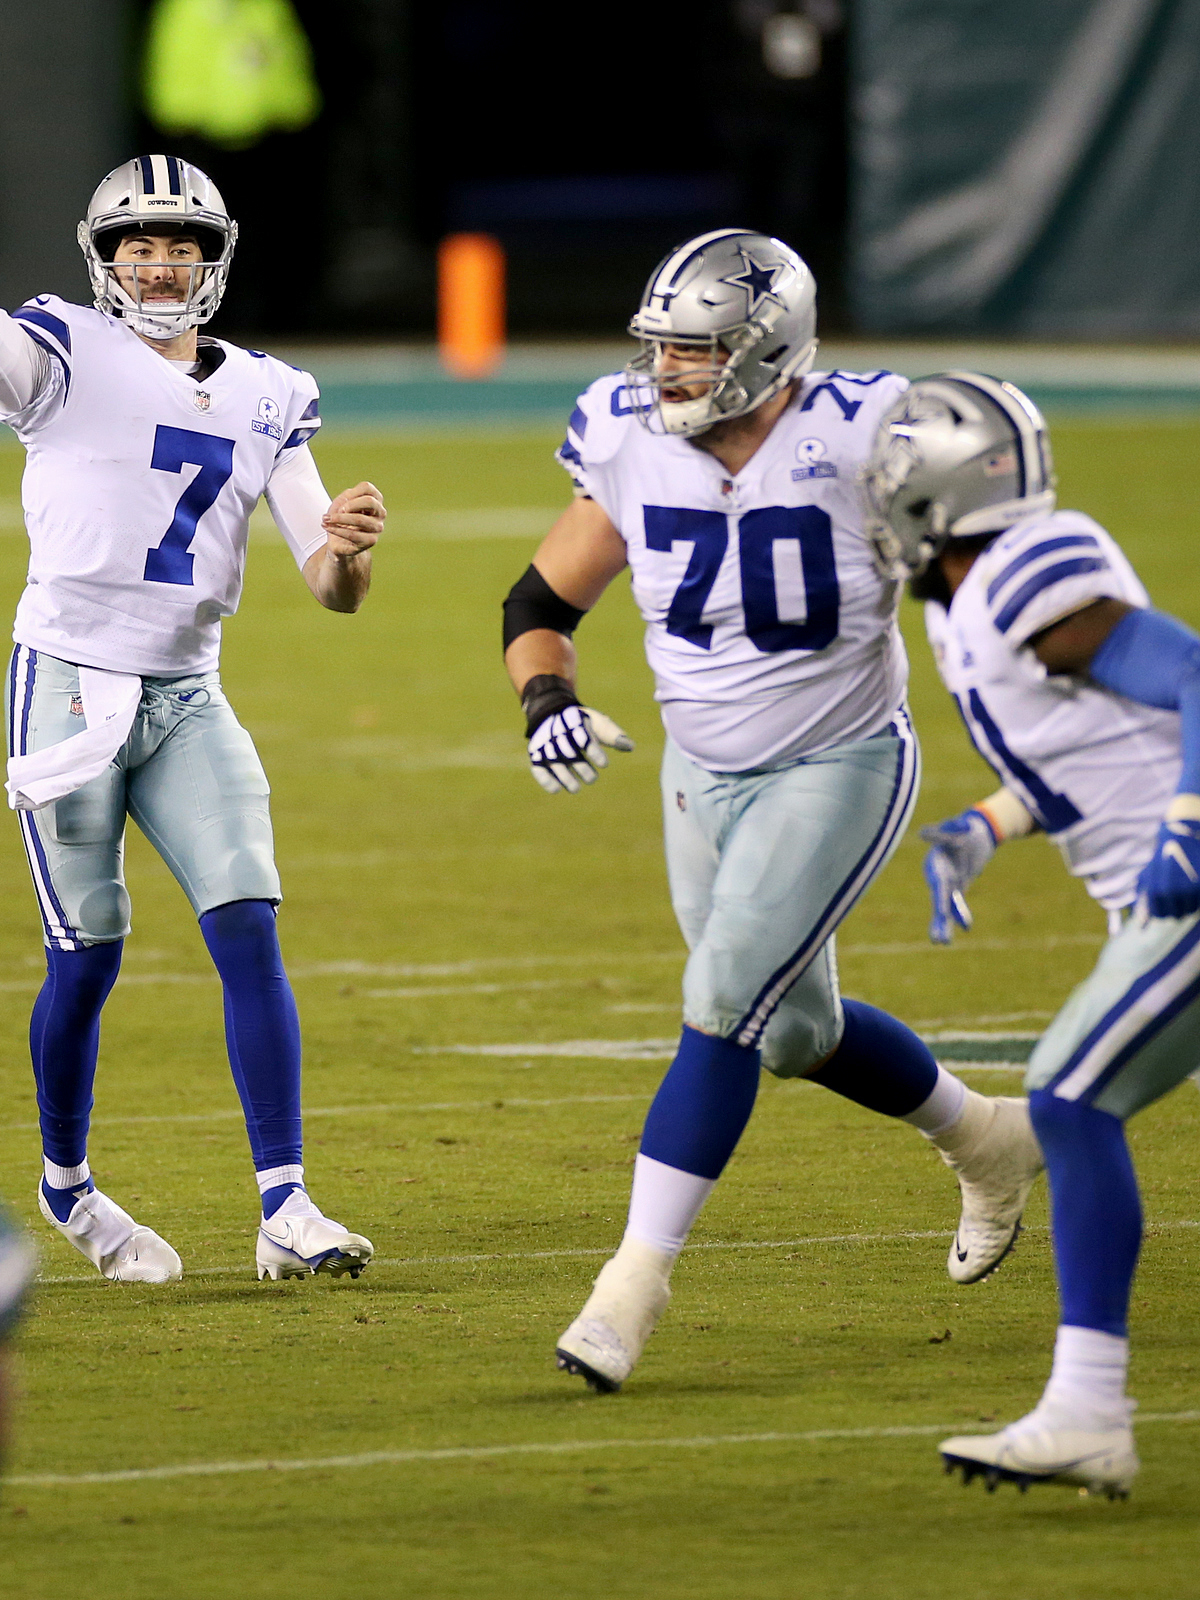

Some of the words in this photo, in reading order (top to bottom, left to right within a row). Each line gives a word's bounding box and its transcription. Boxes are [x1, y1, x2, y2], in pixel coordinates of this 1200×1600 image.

[252, 421, 267, 434] EST.
[143, 424, 236, 586] 7
[642, 504, 840, 653] 70
[951, 686, 1084, 834] 1
